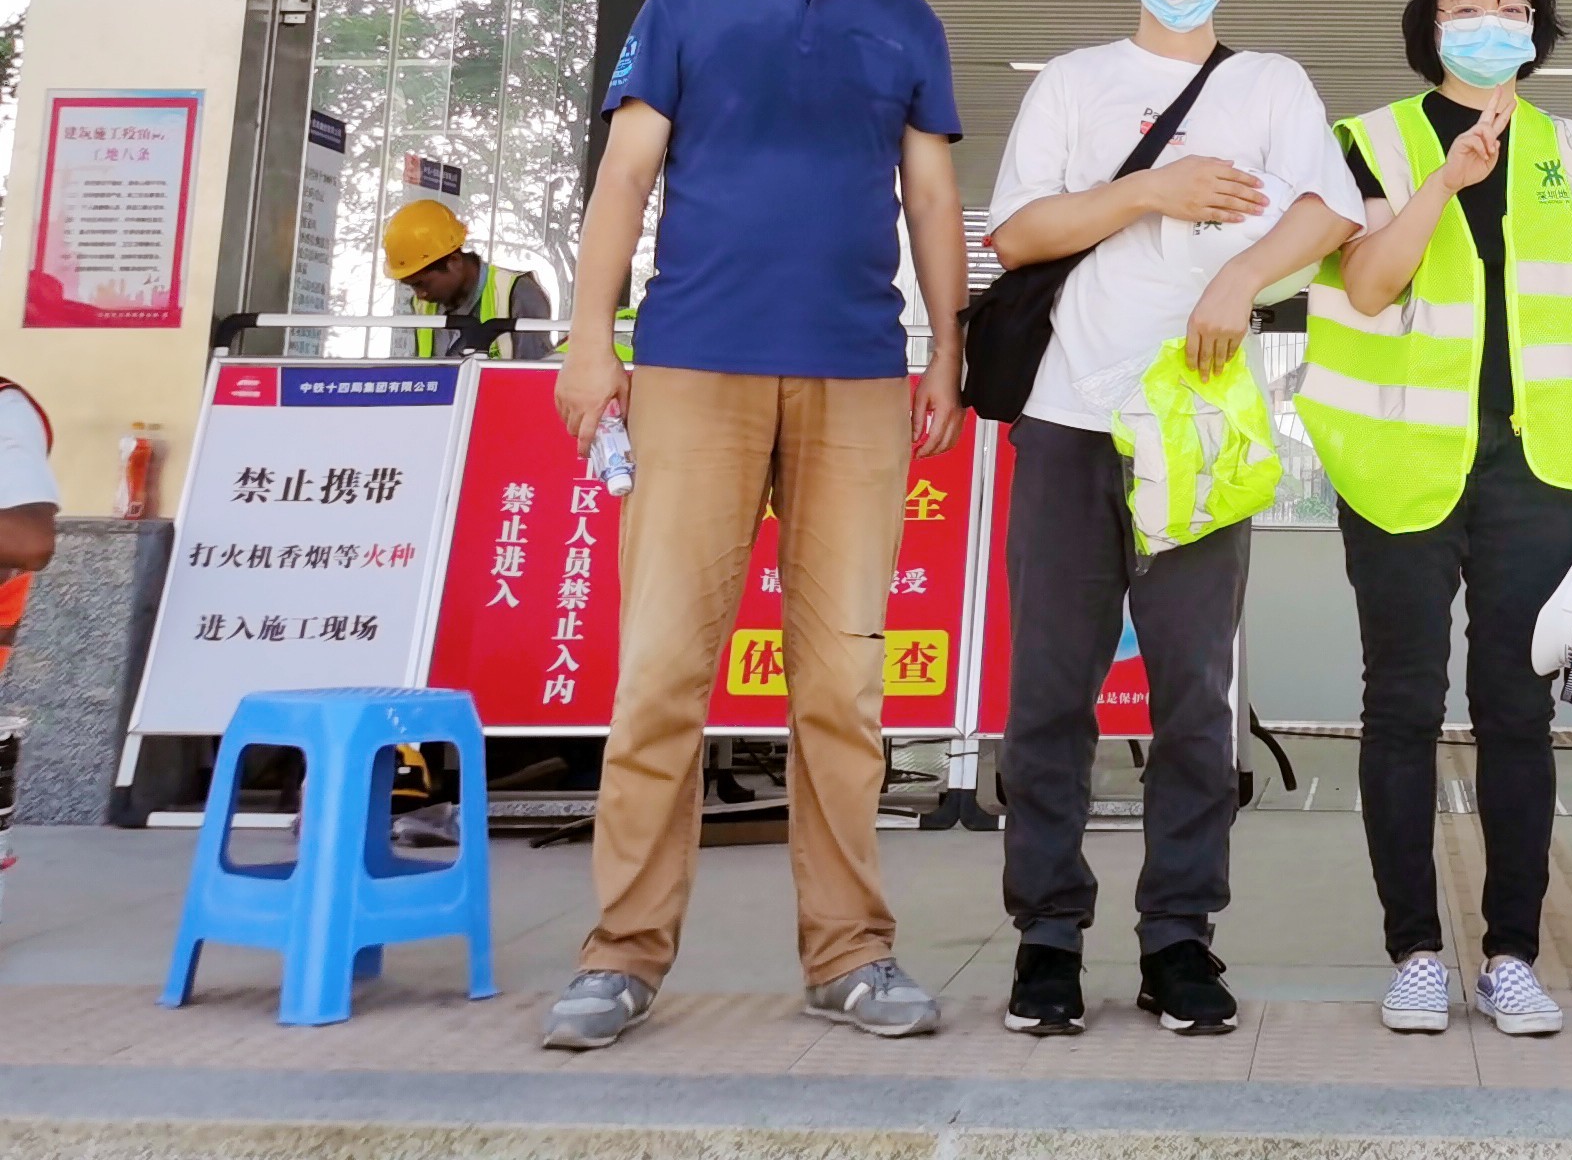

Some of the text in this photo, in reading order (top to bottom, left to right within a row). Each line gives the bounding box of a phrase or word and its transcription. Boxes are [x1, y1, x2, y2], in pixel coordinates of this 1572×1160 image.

[300, 381, 439, 393] 中铁十四局集团有限公司
[230, 466, 404, 504] 禁止携带
[189, 542, 416, 569] 打火机香烟等火种
[486, 482, 535, 609] 禁止进入
[195, 614, 378, 641] 进入施工现场
[1096, 691, 1150, 705] 也是保护
